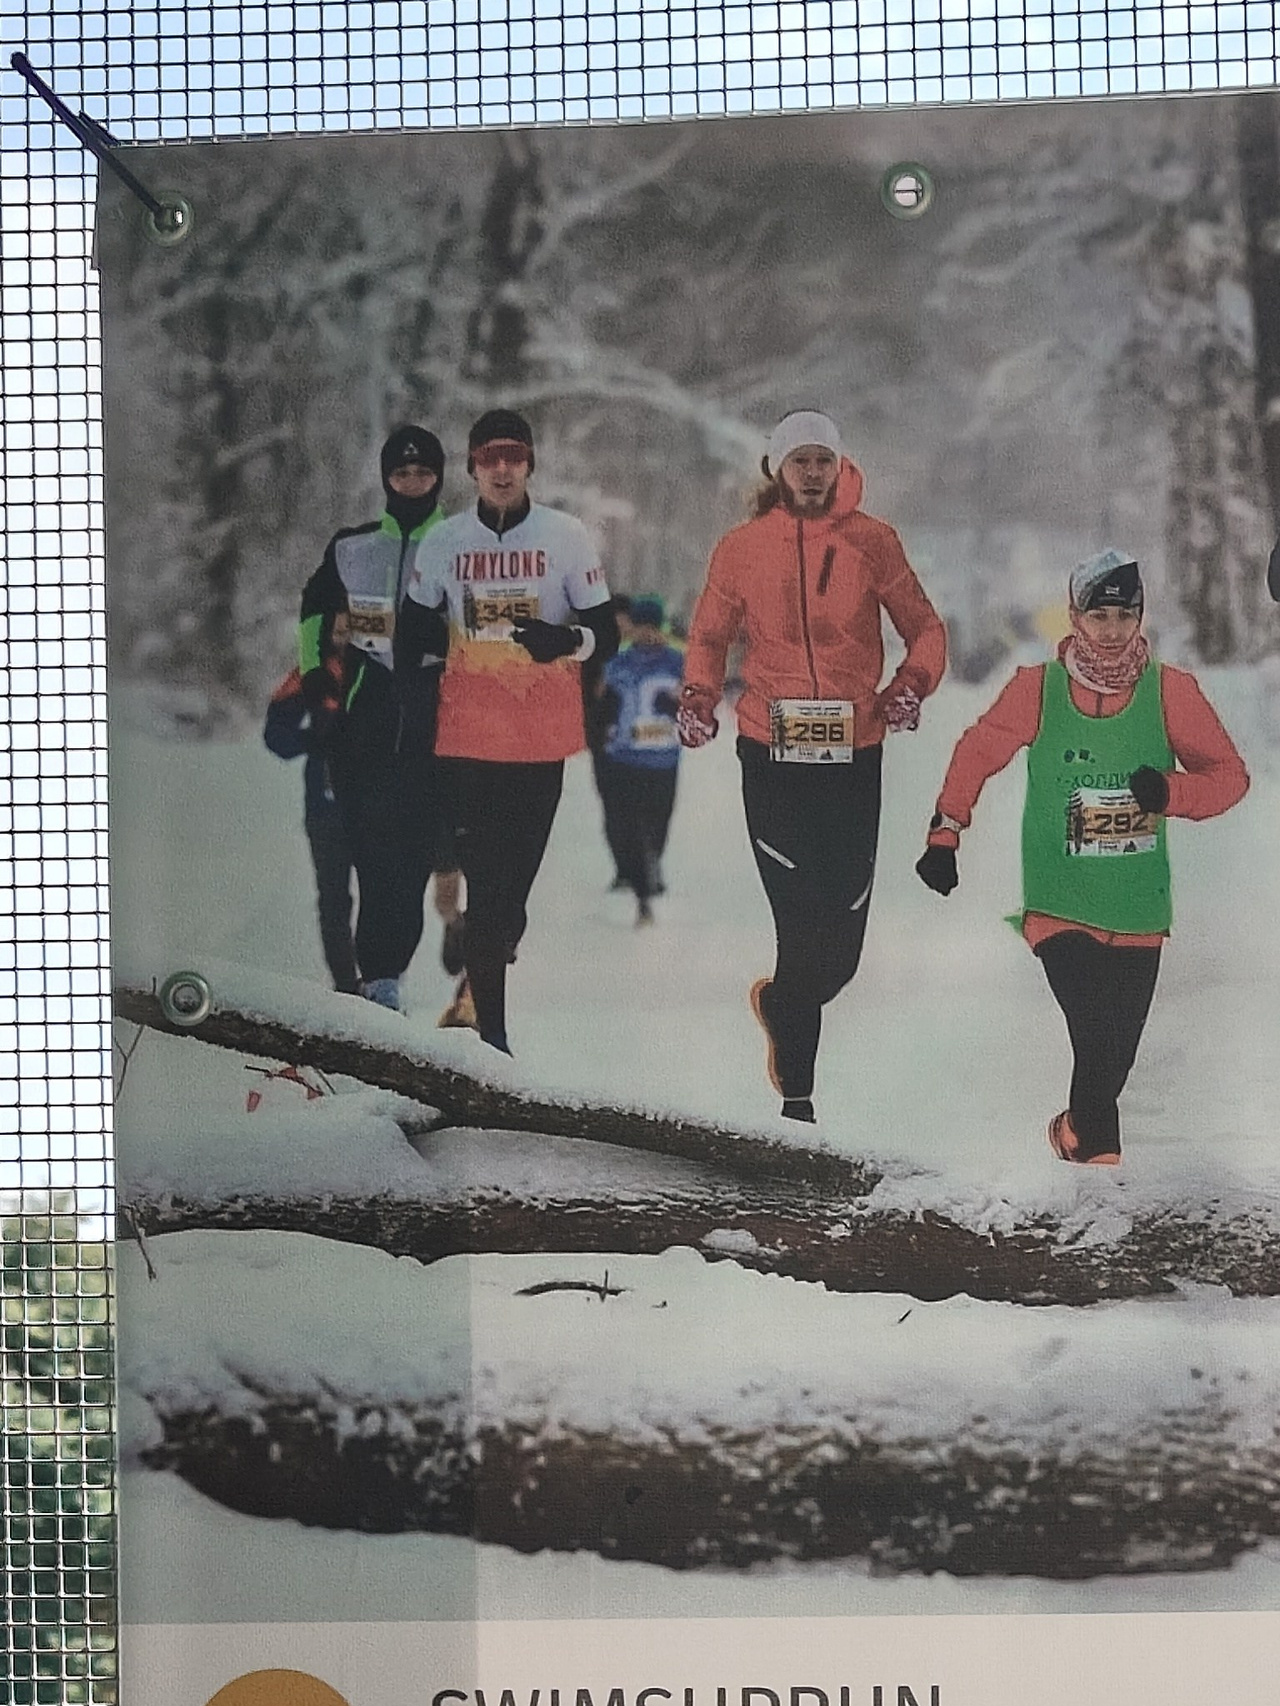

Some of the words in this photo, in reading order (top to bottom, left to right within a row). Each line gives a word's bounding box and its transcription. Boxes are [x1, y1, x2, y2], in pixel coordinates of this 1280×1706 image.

[456, 549, 545, 581] IZMYLONG
[794, 722, 844, 742] 296
[1094, 811, 1150, 835] 292
